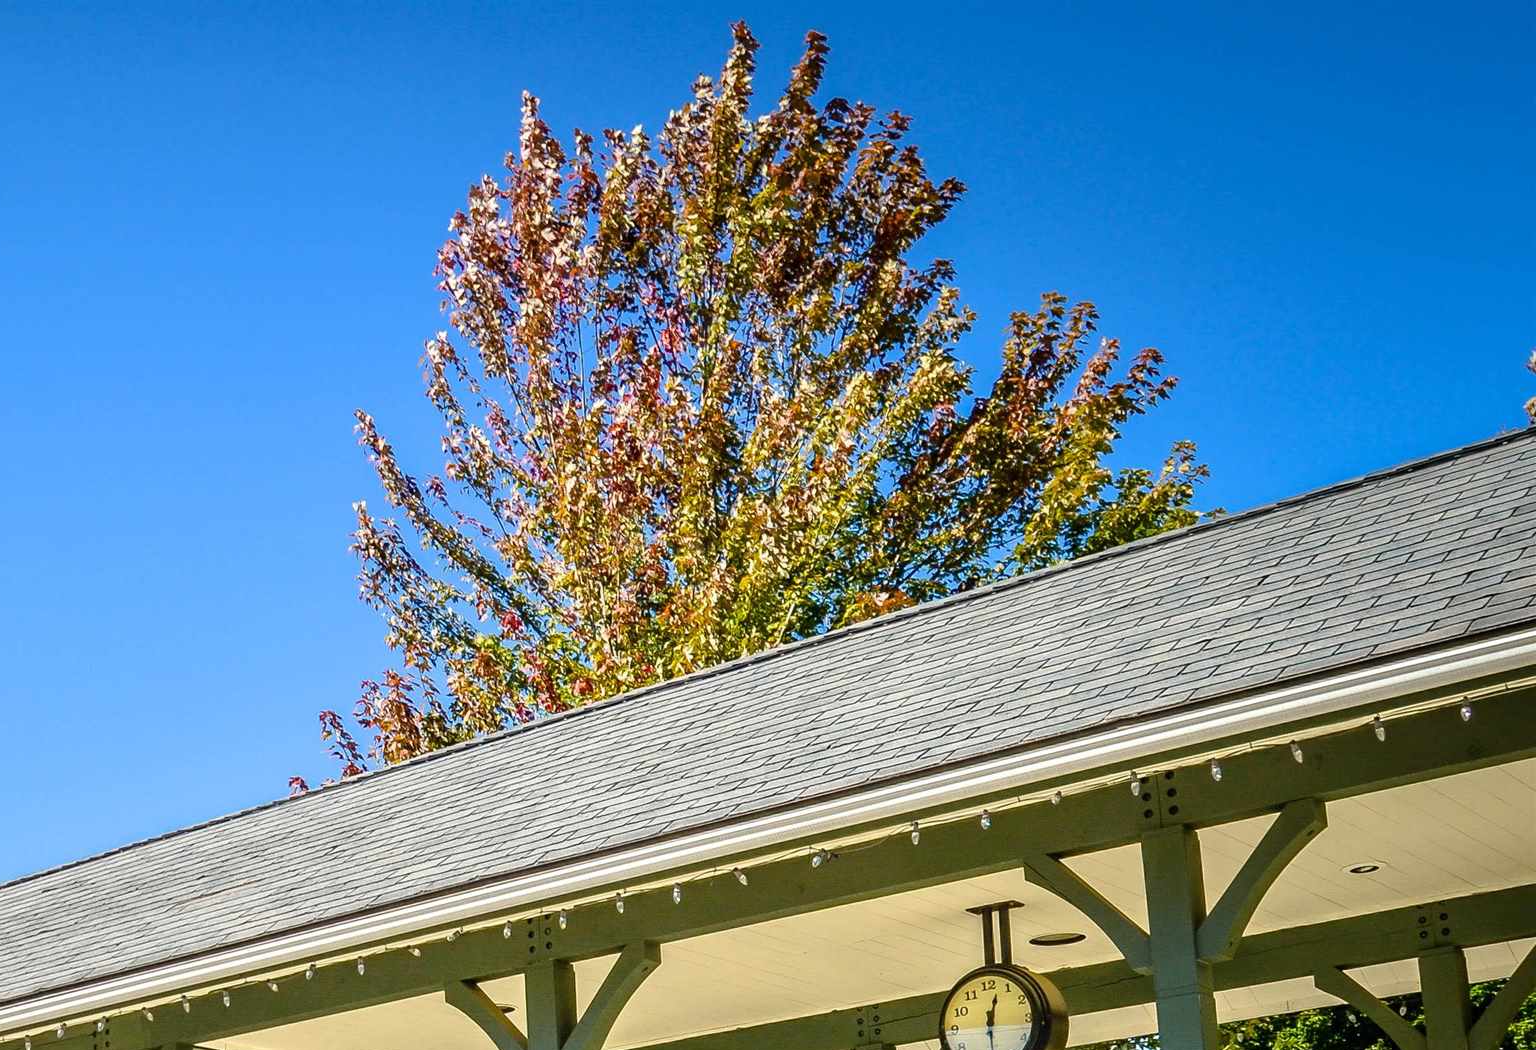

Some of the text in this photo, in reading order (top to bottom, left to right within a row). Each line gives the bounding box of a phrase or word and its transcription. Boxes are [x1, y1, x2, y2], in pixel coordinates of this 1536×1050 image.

[981, 980, 996, 991] 12
[1005, 983, 1012, 993] 1
[965, 990, 978, 1001] 11
[1018, 995, 1026, 1005] 2
[954, 1006, 968, 1017] 10
[1025, 1012, 1032, 1023] 3
[951, 1024, 959, 1036] 9
